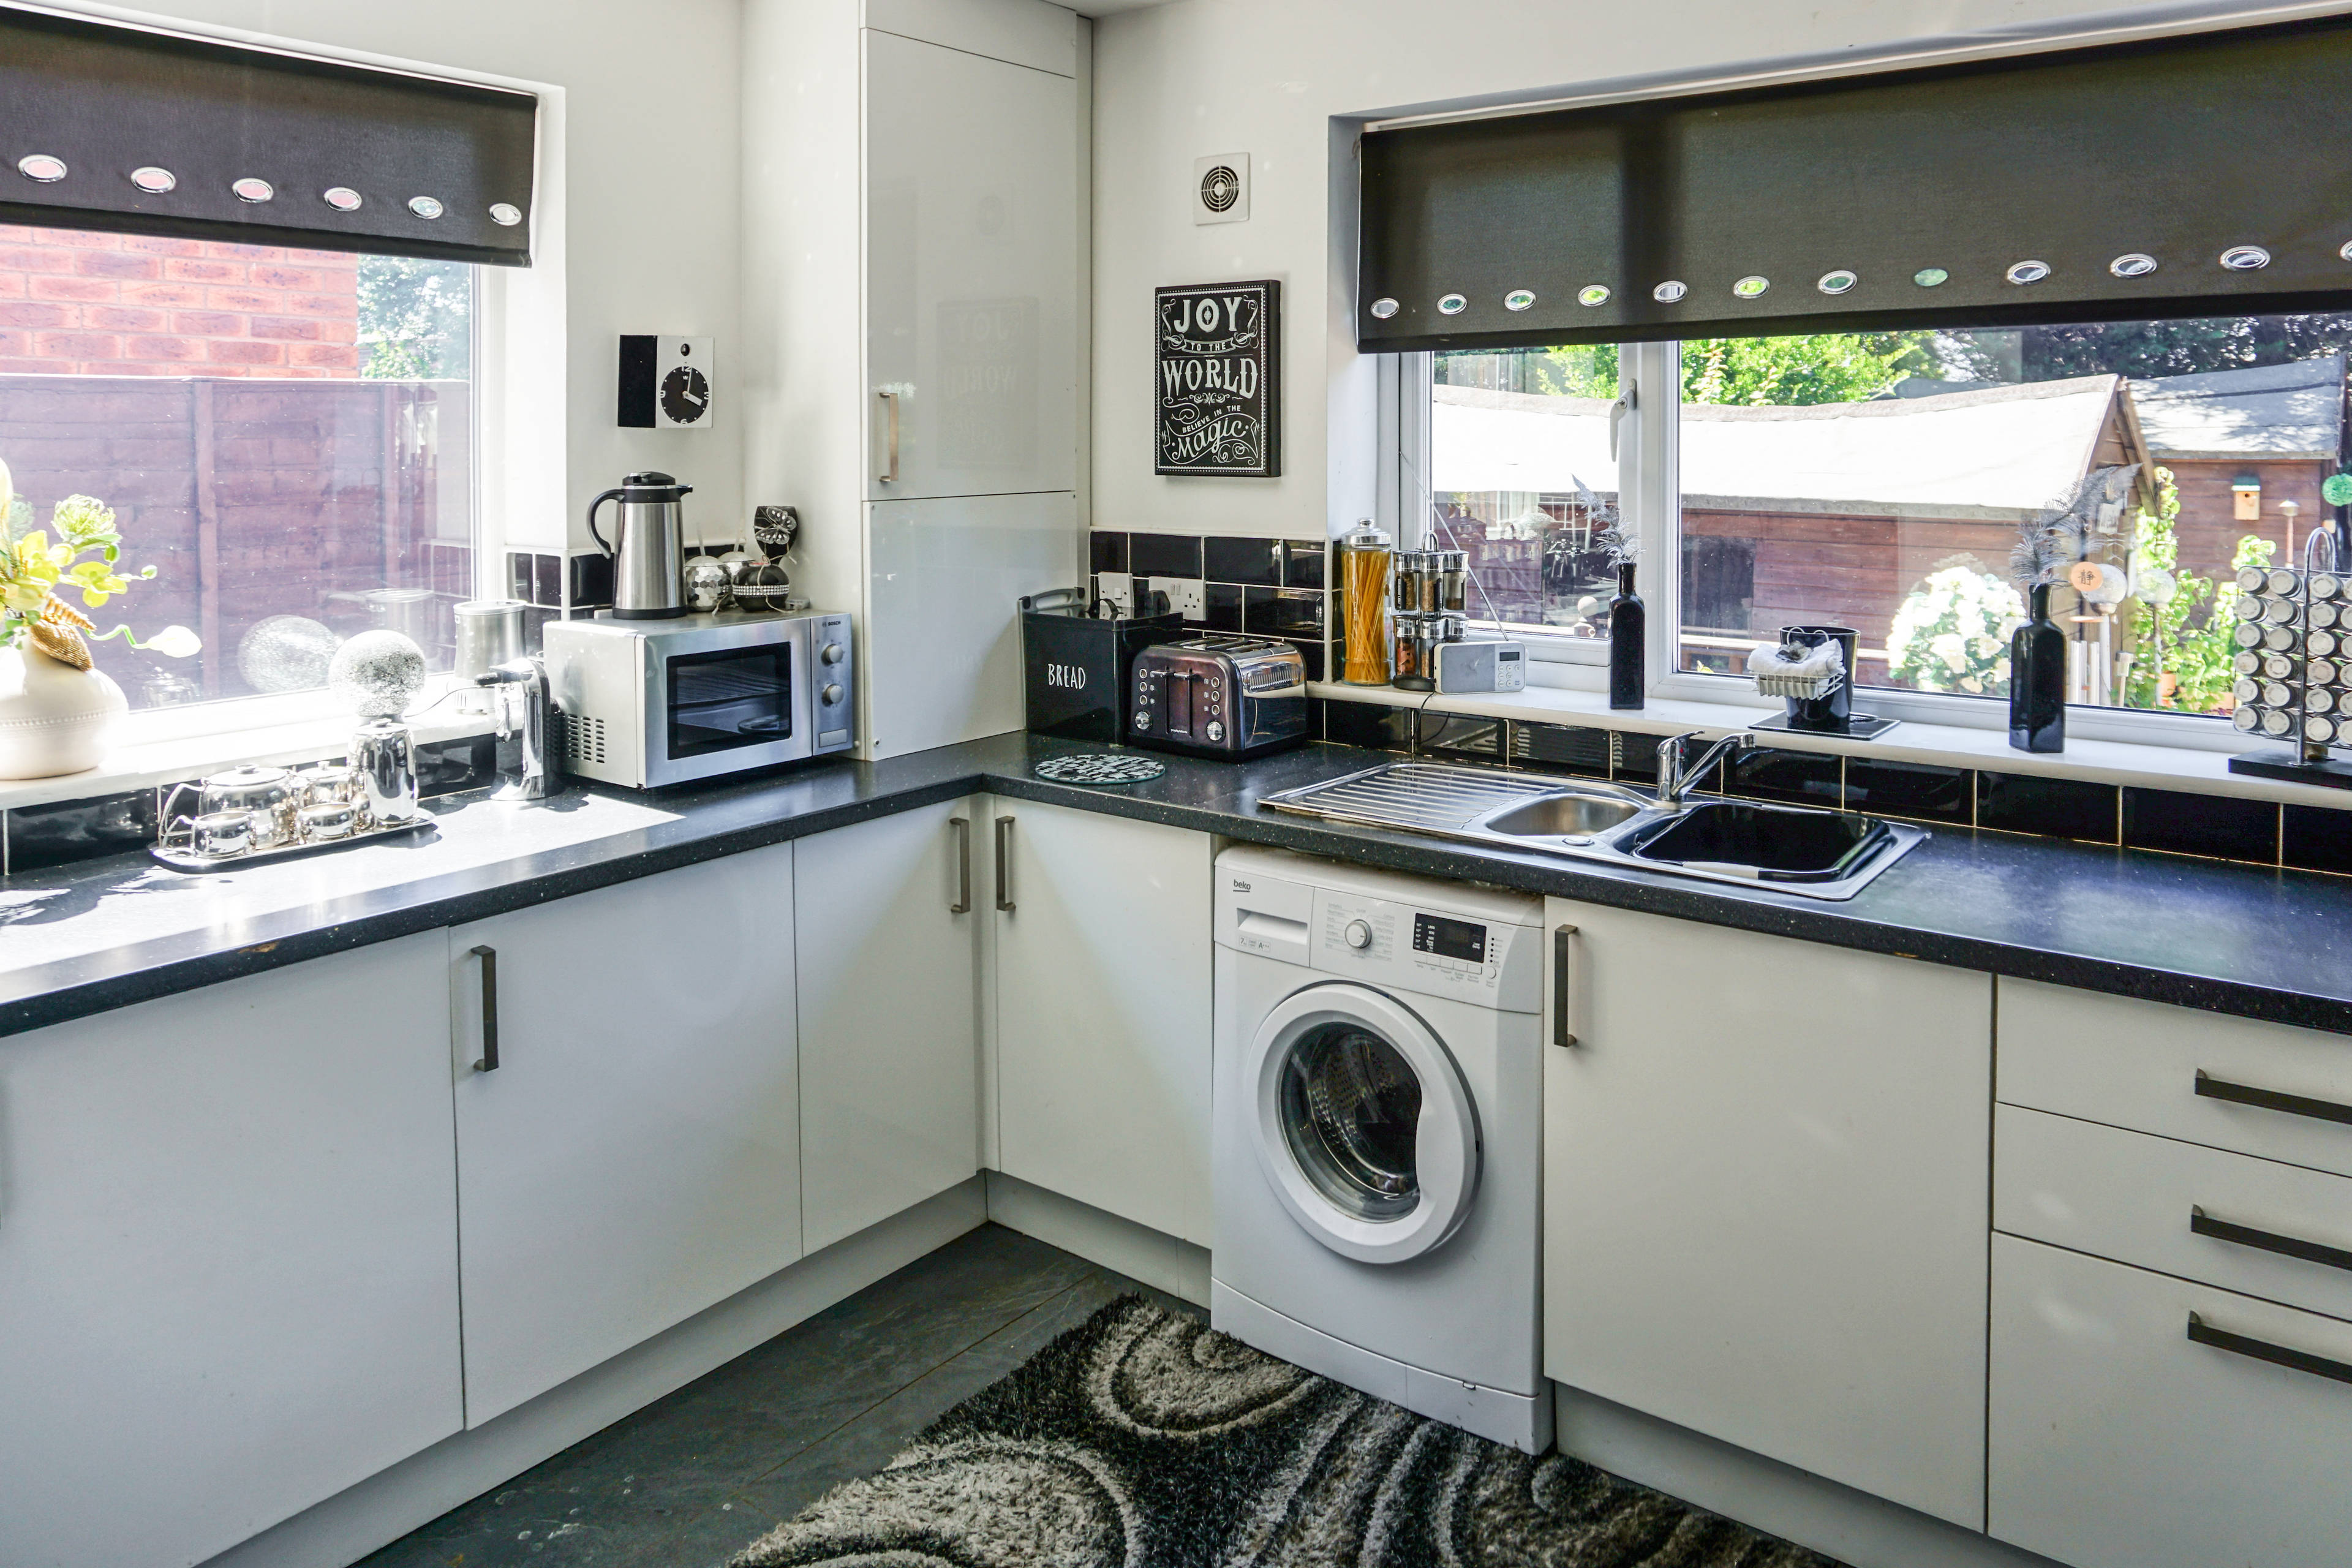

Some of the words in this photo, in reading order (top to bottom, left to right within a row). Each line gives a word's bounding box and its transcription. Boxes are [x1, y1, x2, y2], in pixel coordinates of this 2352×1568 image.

[1174, 296, 1242, 333] JOY
[1191, 342, 1201, 352] TO
[1208, 342, 1226, 352] THE
[1161, 357, 1258, 399] WORLD
[703, 391, 709, 400] 3
[1182, 415, 1211, 434] BELIEVE
[1213, 409, 1223, 417] IN
[1226, 404, 1242, 413] THE
[1171, 417, 1247, 460] Magic
[1047, 663, 1086, 690] BREAD
[1233, 878, 1251, 891] beko
